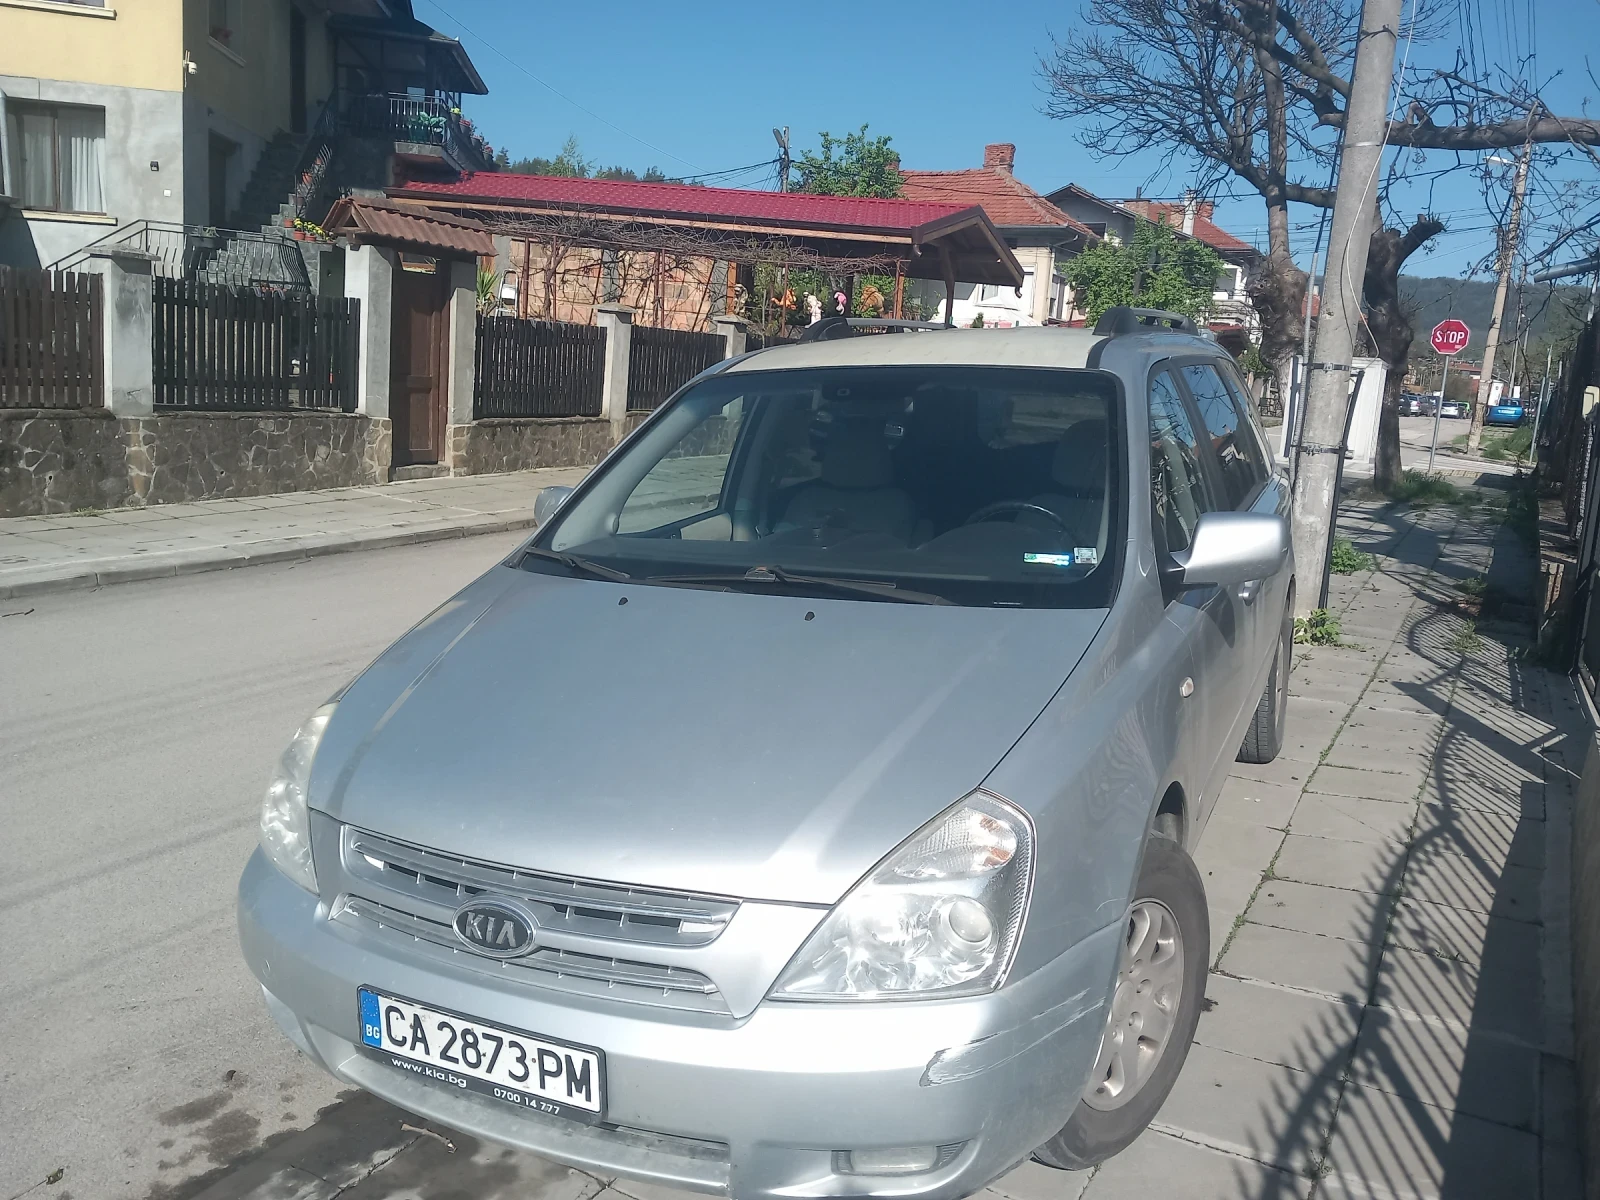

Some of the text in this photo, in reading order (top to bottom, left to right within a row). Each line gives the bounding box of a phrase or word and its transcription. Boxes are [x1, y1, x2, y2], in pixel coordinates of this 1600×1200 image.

[1435, 330, 1465, 344] STOP
[465, 911, 517, 948] KIA
[365, 1023, 380, 1039] BG
[385, 1005, 592, 1103] CA 2873 PM
[391, 1058, 467, 1088] www.kia.bg
[493, 1087, 560, 1115] 0700 14 777
